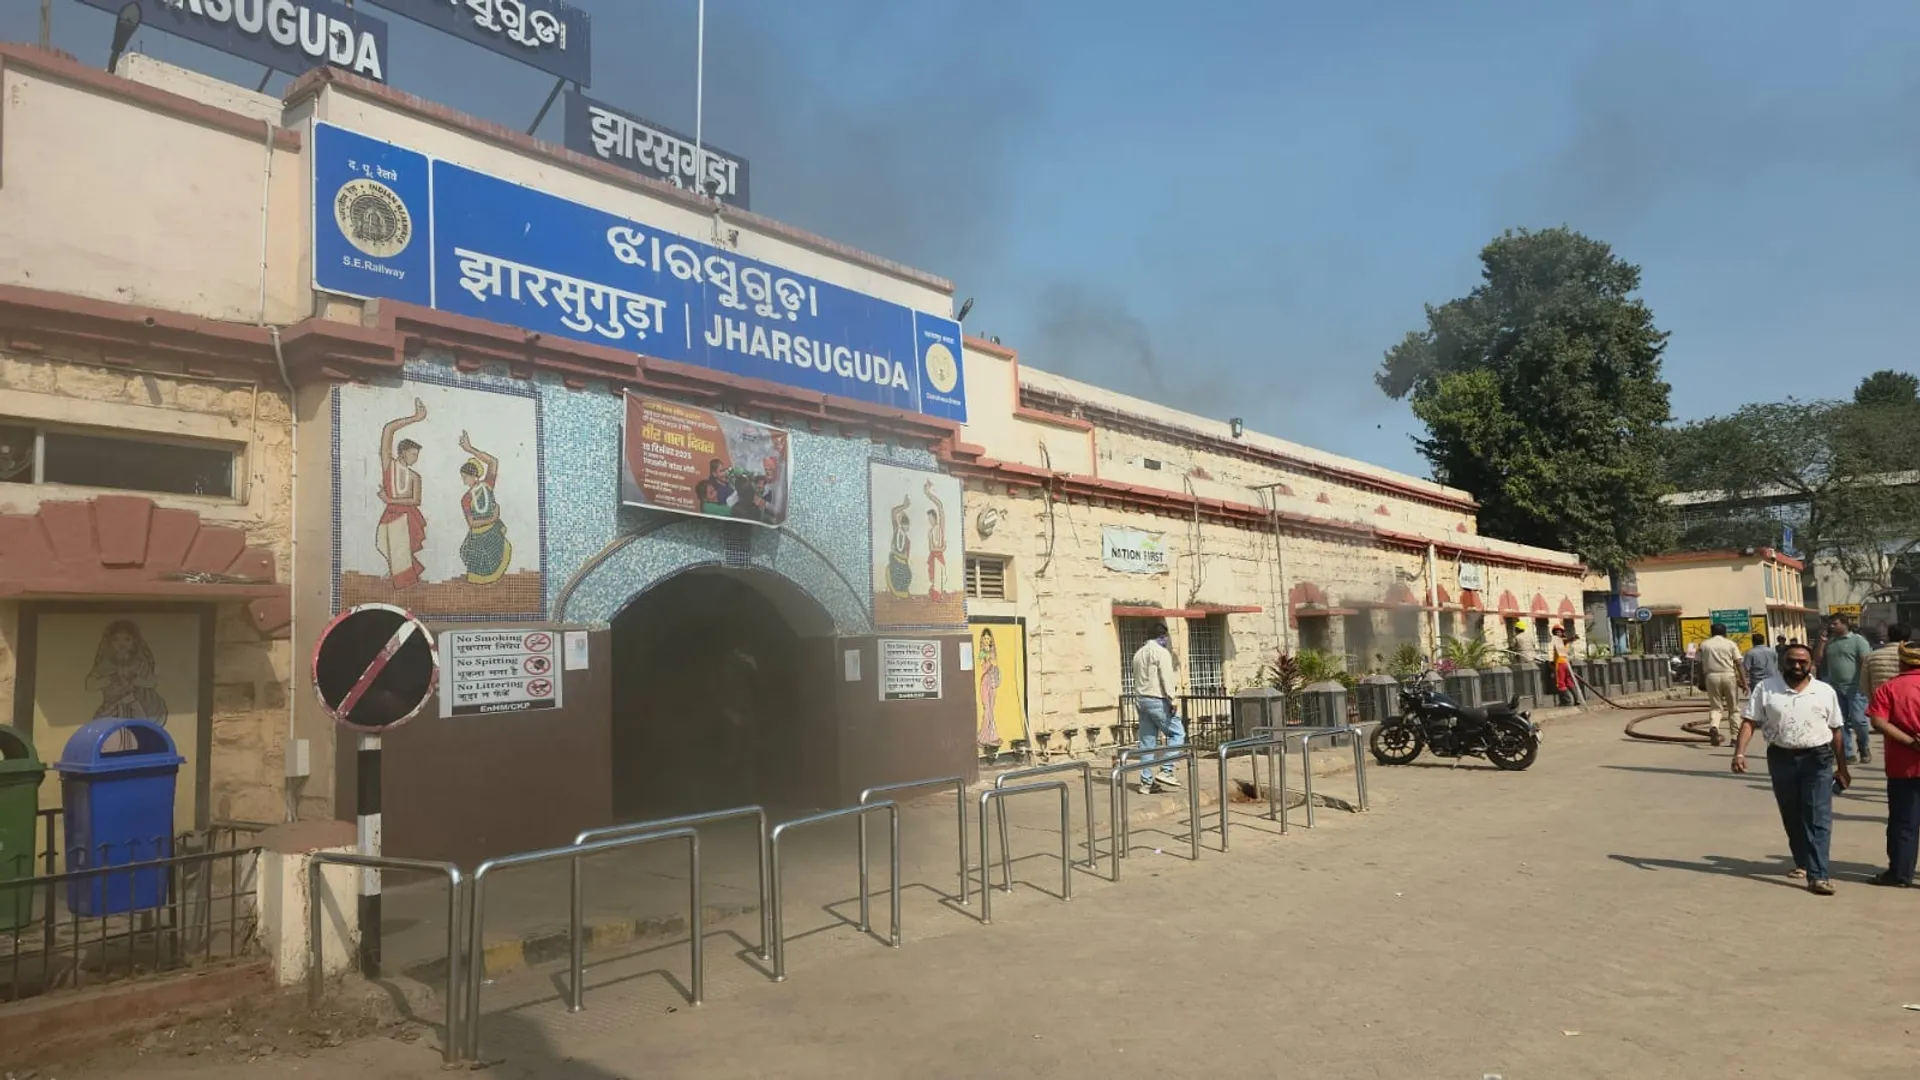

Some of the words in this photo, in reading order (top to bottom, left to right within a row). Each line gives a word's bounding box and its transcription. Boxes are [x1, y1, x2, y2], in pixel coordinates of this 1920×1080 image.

[454, 247, 667, 340] झारसुगुड़ा
[704, 314, 910, 392] JHARSUGUDA
[1111, 548, 1141, 560] NATION
[1143, 550, 1164, 562] FIRST
[474, 634, 522, 644] Smoking
[457, 659, 472, 667] No
[475, 657, 518, 668] Spitting
[457, 683, 473, 691] No
[476, 681, 523, 691] Littering
[480, 702, 530, 713] EnHM/CKP
